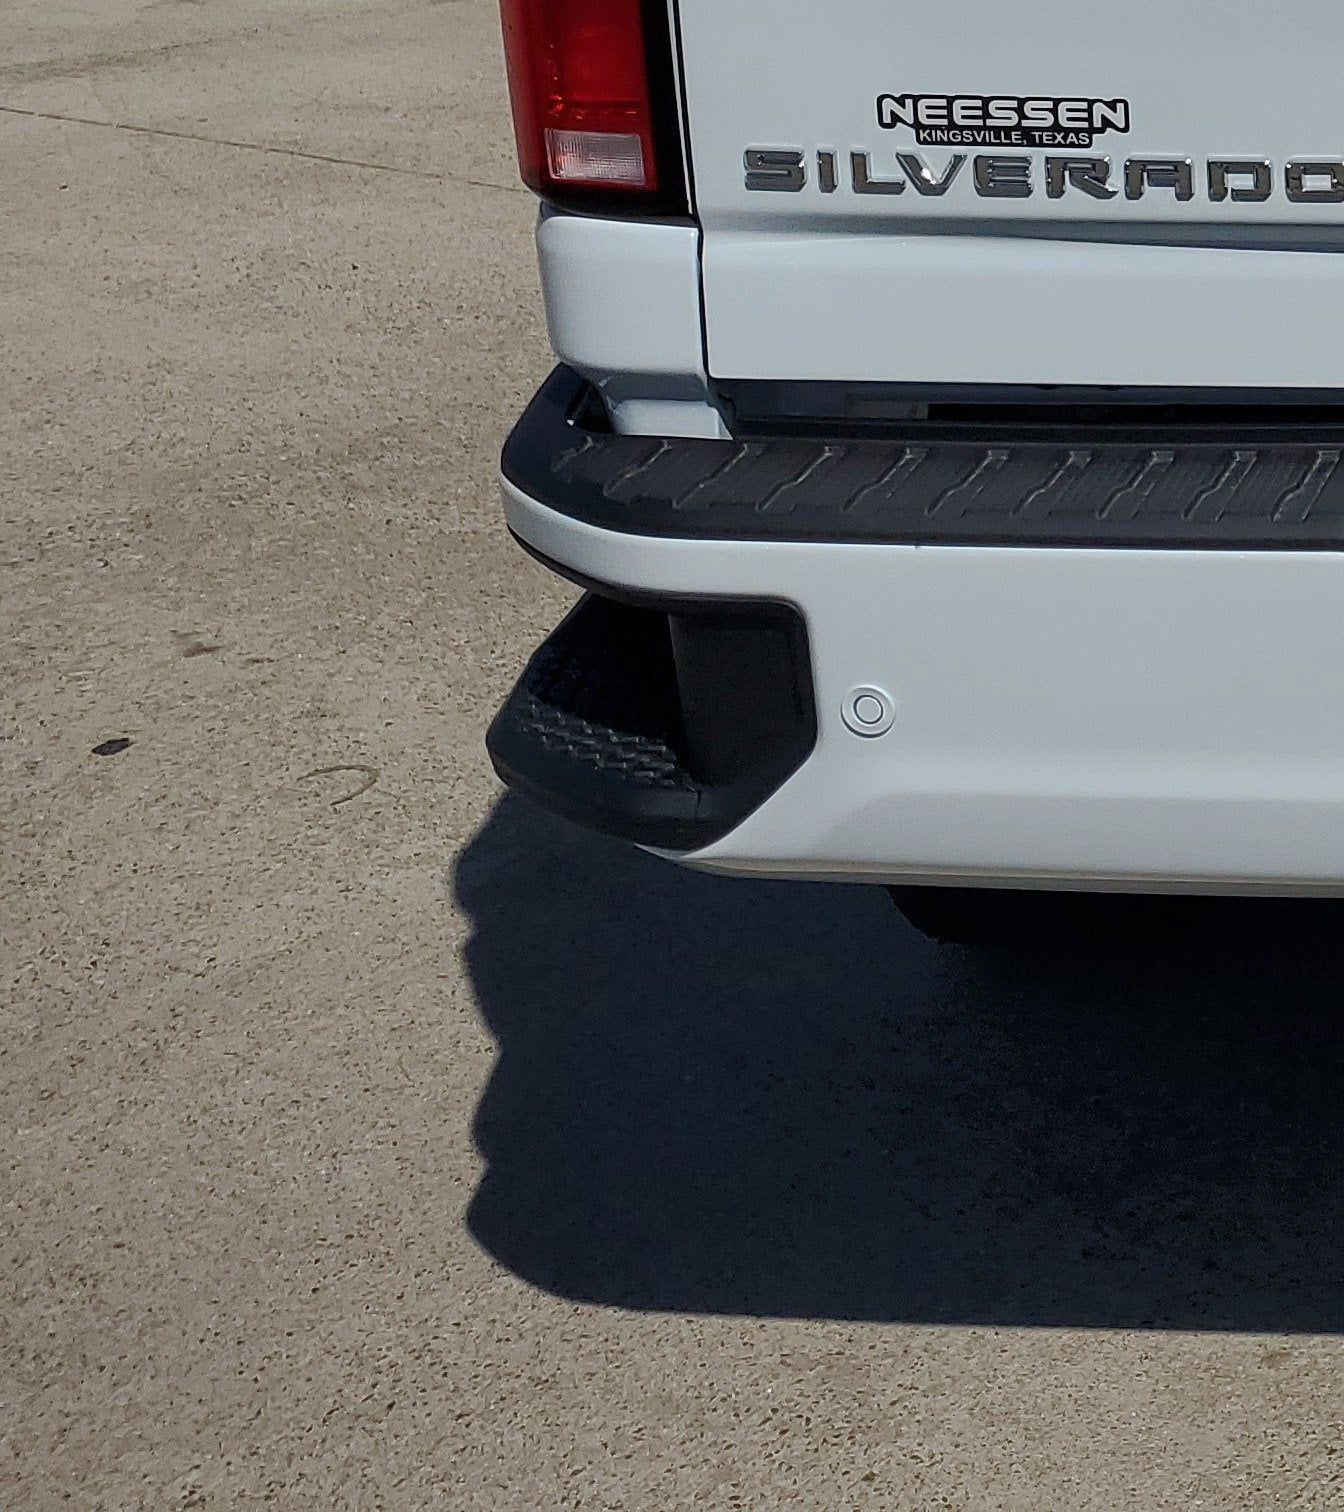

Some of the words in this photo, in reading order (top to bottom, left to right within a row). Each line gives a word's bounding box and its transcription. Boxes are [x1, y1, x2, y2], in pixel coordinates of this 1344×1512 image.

[880, 96, 1127, 130] NEESSEN
[918, 128, 1027, 145] KINGSVILLE,
[1031, 130, 1091, 145] TEXAS
